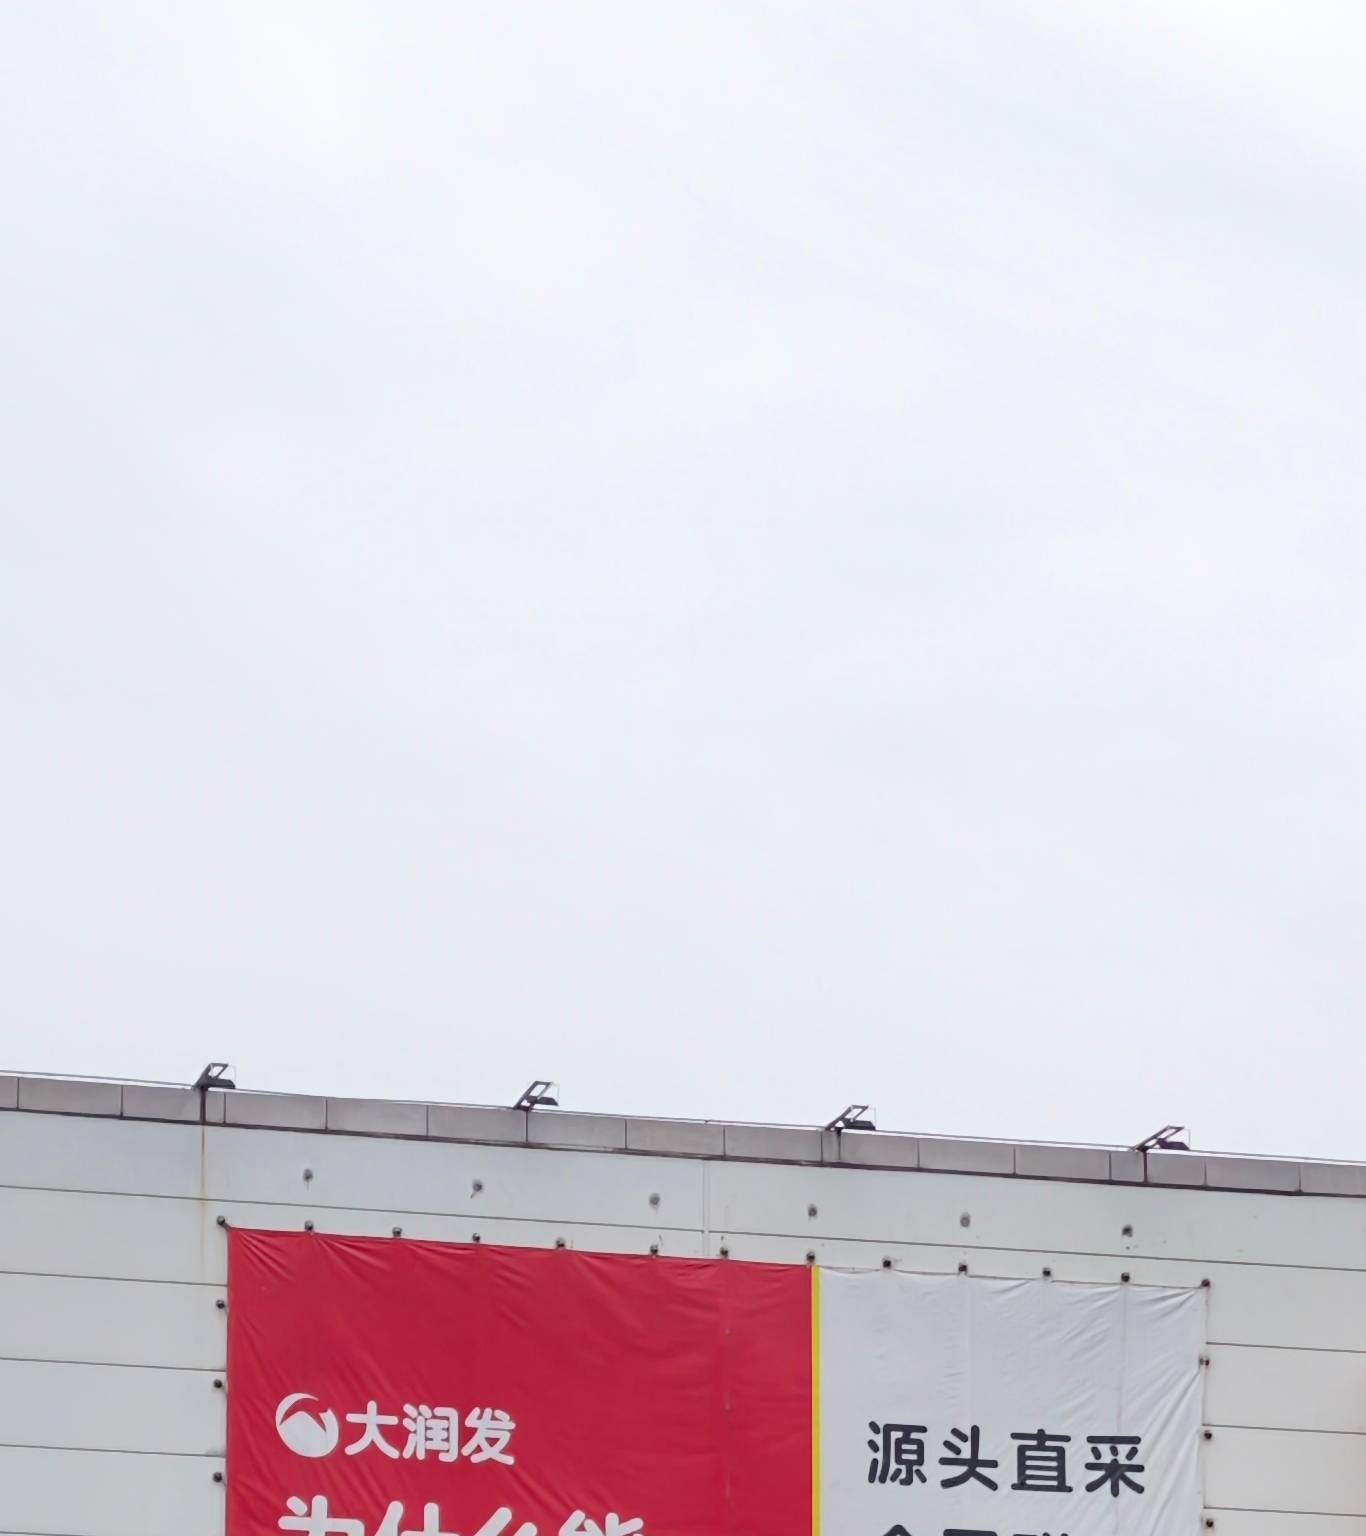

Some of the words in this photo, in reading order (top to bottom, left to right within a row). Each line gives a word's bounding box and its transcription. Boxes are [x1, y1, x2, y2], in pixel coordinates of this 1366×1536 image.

[345, 1400, 516, 1465] 大润发
[867, 1420, 1146, 1498] 源头直采
